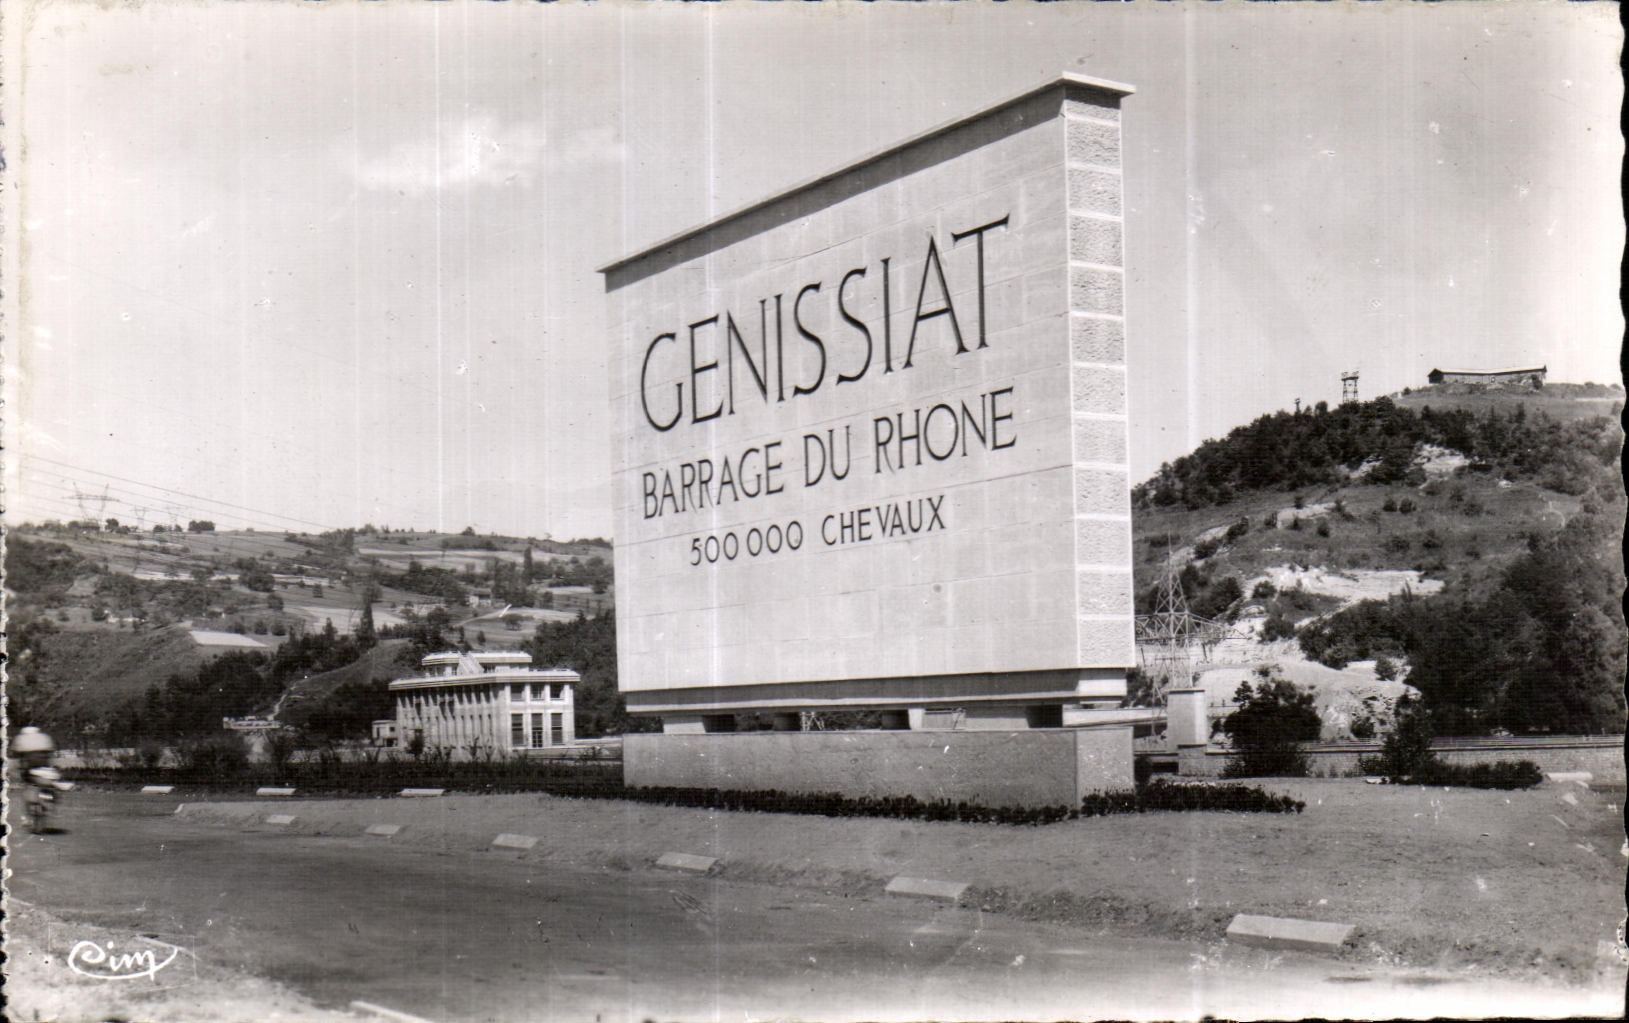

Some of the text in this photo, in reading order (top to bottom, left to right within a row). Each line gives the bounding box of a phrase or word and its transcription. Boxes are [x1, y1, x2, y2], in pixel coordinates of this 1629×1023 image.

[640, 213, 1010, 432] GENISSIAT
[642, 386, 1017, 520] BARRAGE DU RHONE
[821, 495, 946, 546] CHEVAUX
